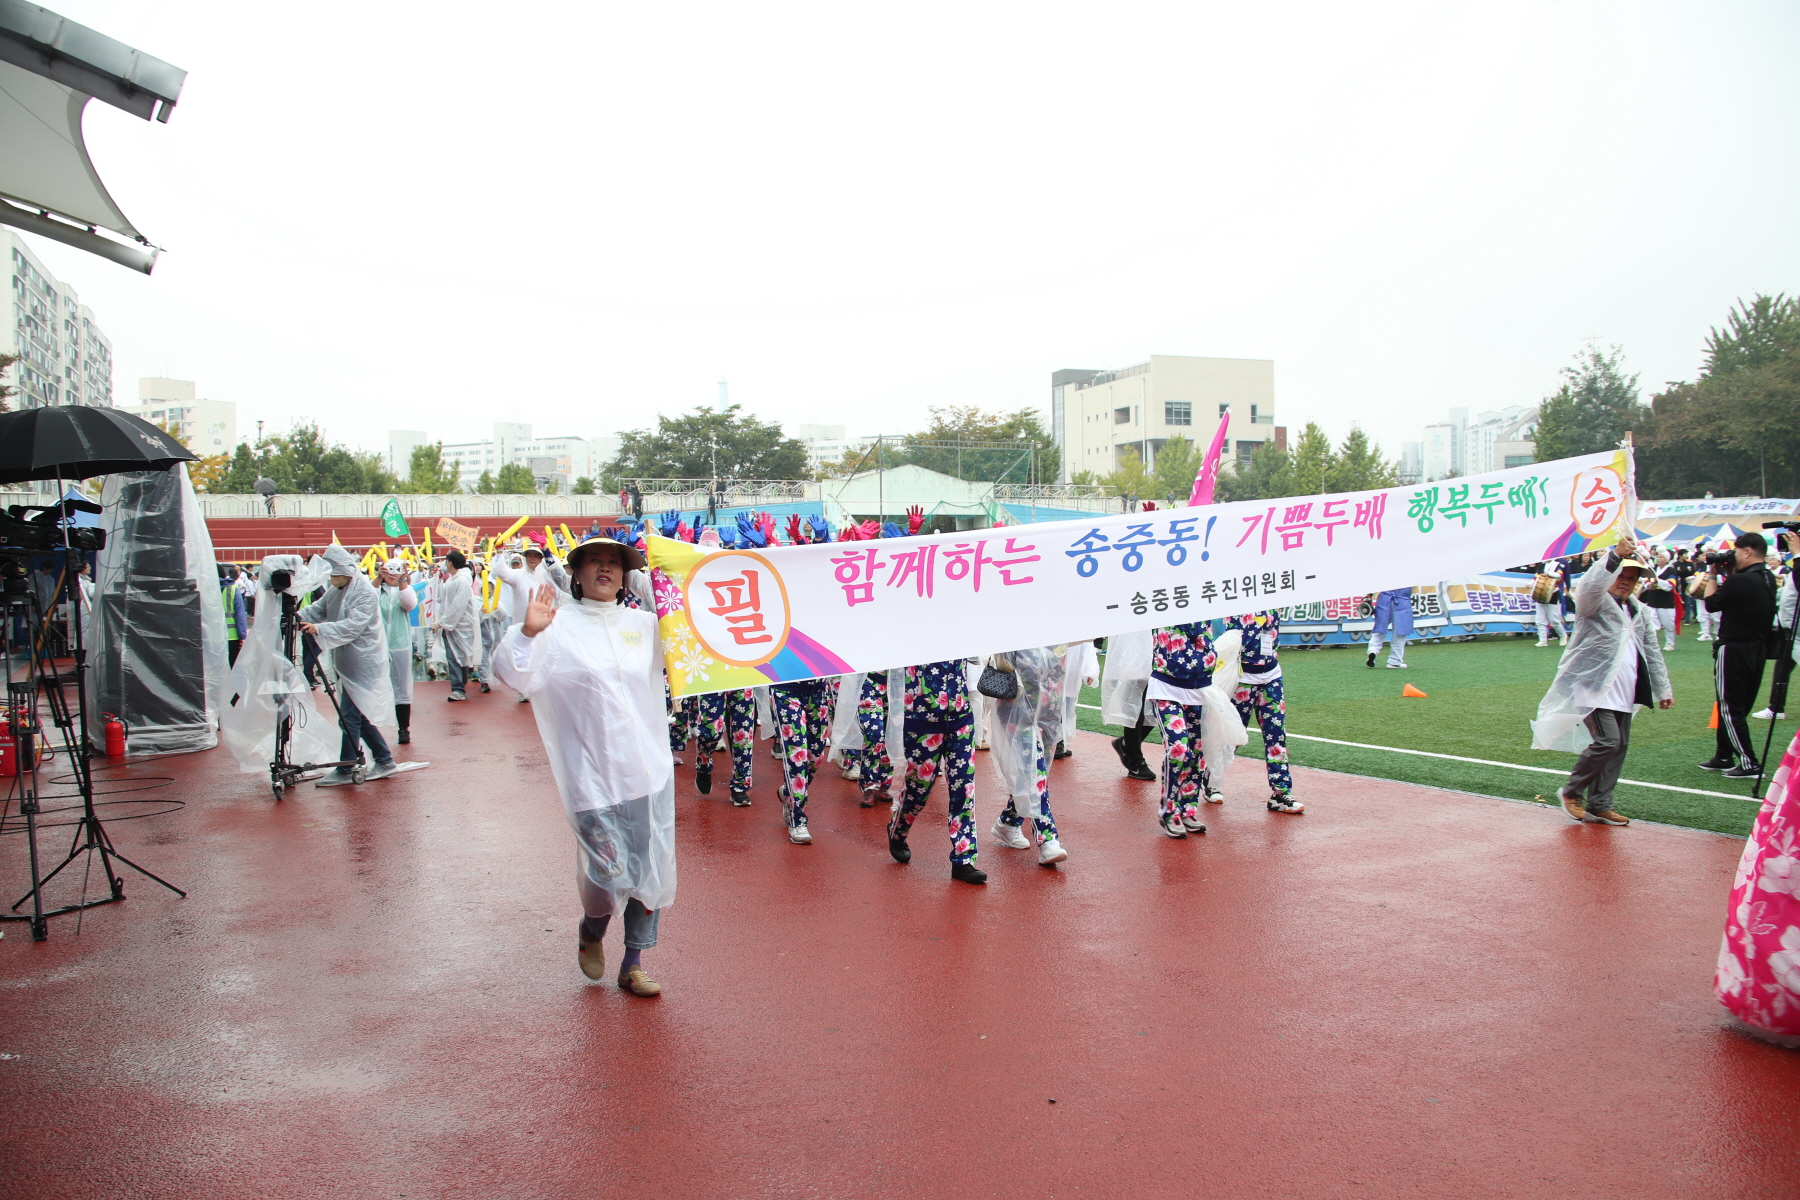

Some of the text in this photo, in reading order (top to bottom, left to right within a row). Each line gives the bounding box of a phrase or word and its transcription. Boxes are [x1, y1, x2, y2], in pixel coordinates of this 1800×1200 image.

[1581, 477, 1616, 525] 승
[830, 476, 1550, 608] 함께하는 송중동! 기쁨두배 행복두배!
[704, 569, 774, 646] 필
[1130, 585, 1191, 616] 송중동
[1200, 568, 1297, 605] 추진위원회
[1466, 590, 1503, 612] 동북부
